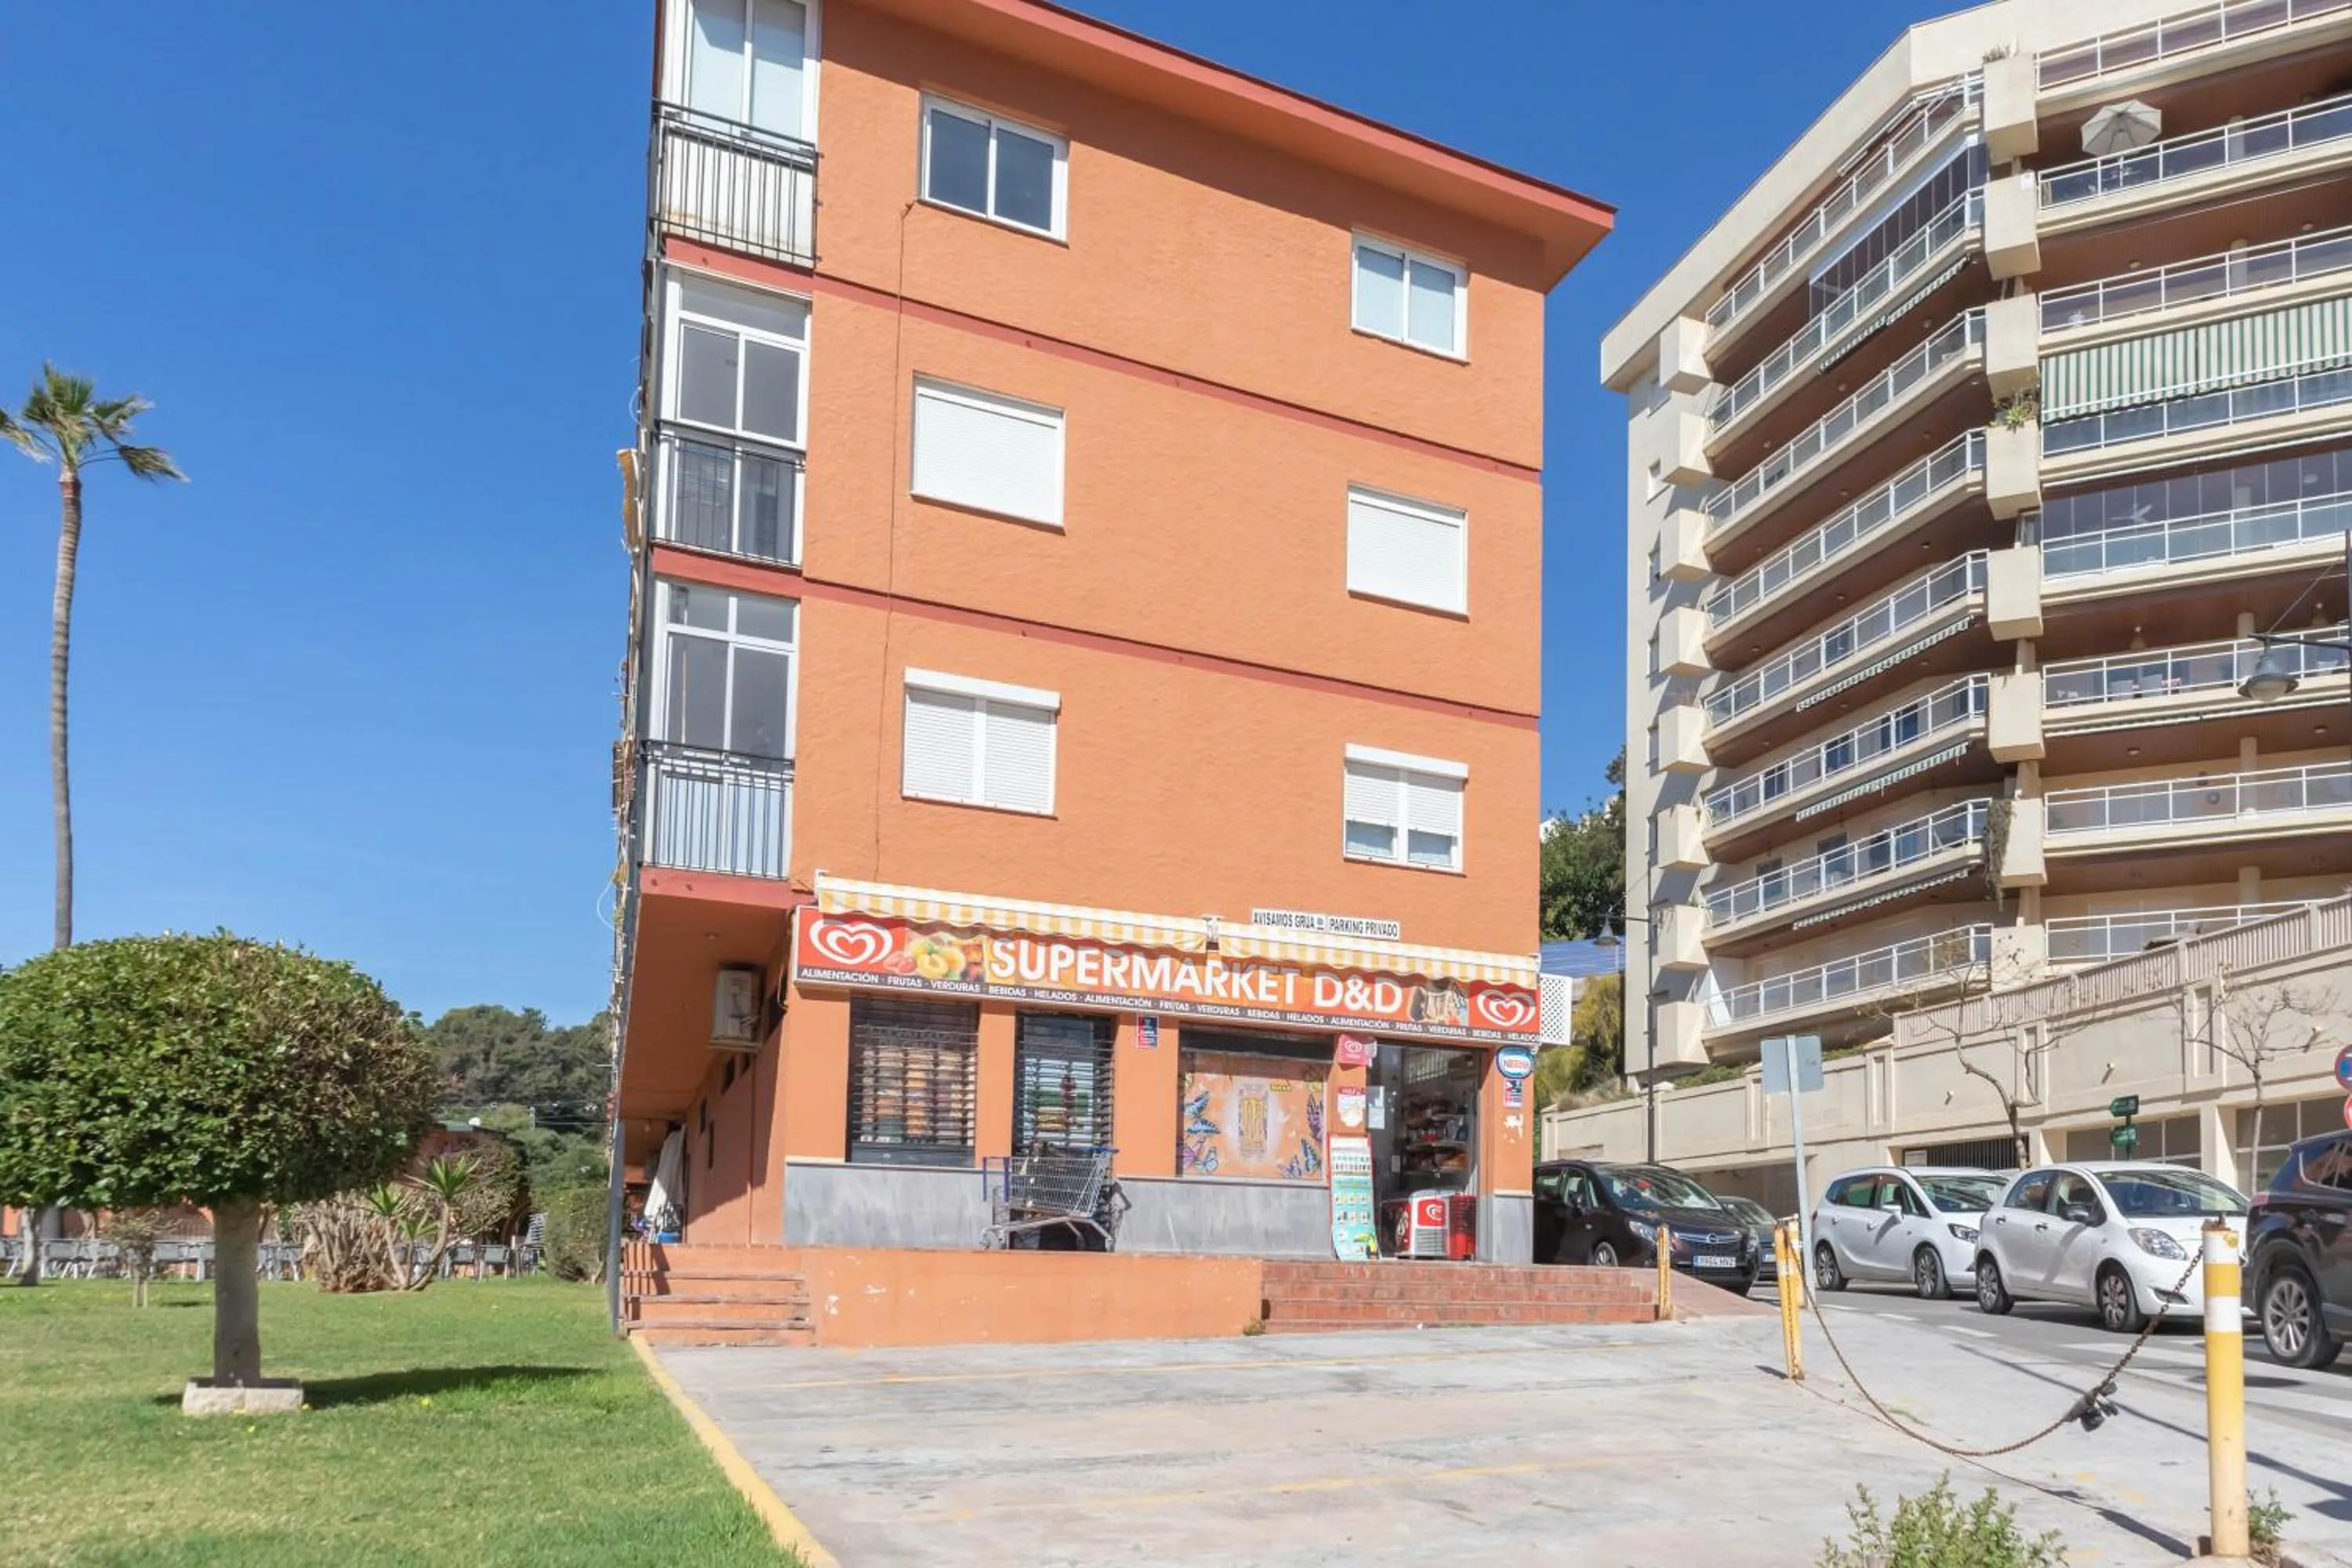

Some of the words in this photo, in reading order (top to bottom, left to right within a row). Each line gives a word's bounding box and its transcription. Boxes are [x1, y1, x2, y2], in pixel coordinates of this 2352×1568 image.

[1254, 912, 1293, 927] AVISAMOS
[1329, 917, 1363, 935] PARKING
[1366, 921, 1398, 938] PRIVADO
[990, 938, 1300, 1004] SUPERMARKET
[1314, 972, 1403, 1014] D&D
[887, 976, 923, 987] FRUTAS
[931, 980, 980, 993] VERDURAS
[988, 985, 1026, 997] BEBIDAS
[1034, 989, 1077, 1002] HELADOS
[1160, 1000, 1190, 1011] FRUTAS
[1196, 1004, 1240, 1017] VERDURAS
[1247, 1009, 1280, 1020] BEBIDAS
[1287, 1013, 1325, 1023] HELADOS
[1396, 1022, 1423, 1033] FRUTAS
[1428, 1025, 1467, 1036] VERDURAS
